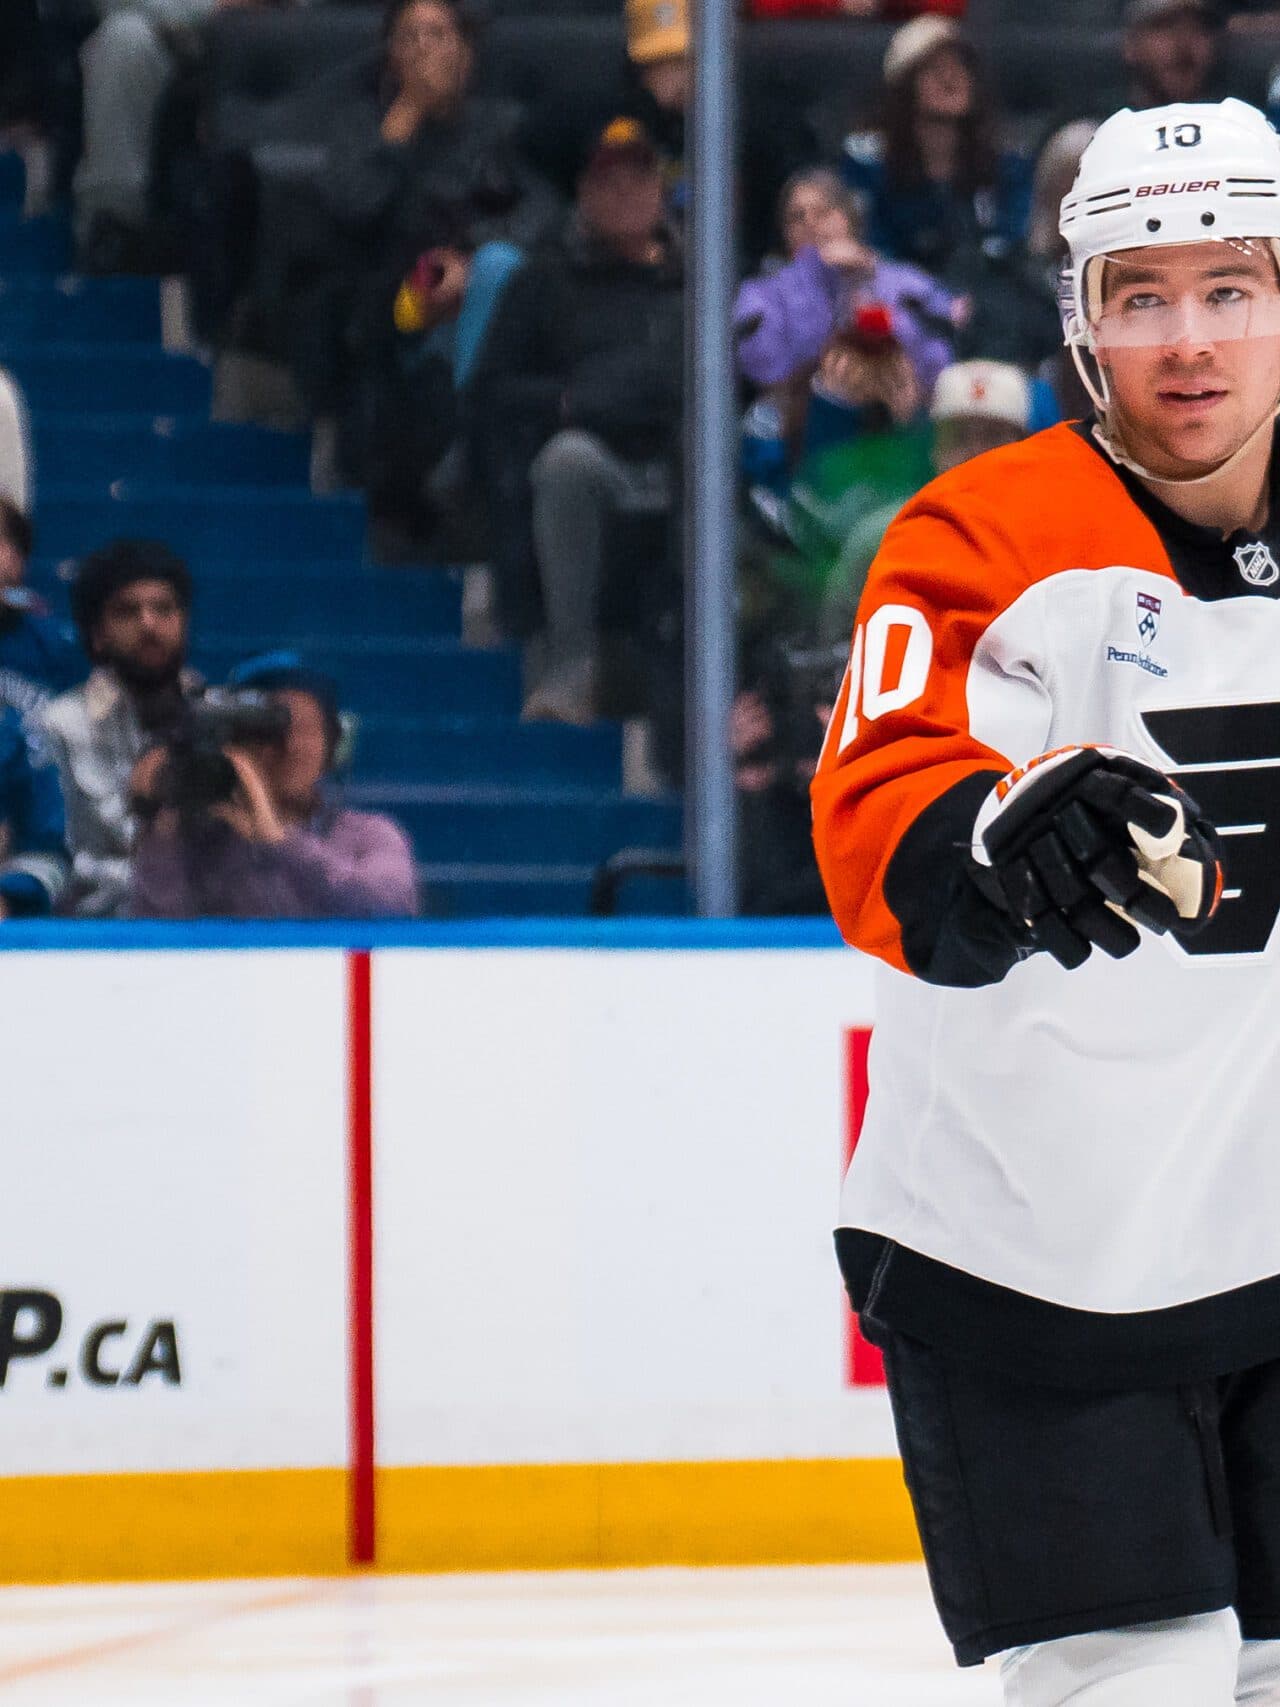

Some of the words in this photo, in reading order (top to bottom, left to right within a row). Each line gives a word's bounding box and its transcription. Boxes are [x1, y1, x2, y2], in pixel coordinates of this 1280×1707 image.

[1155, 123, 1201, 151] 10
[836, 604, 933, 757] 10
[0, 1289, 182, 1388] P.CA
